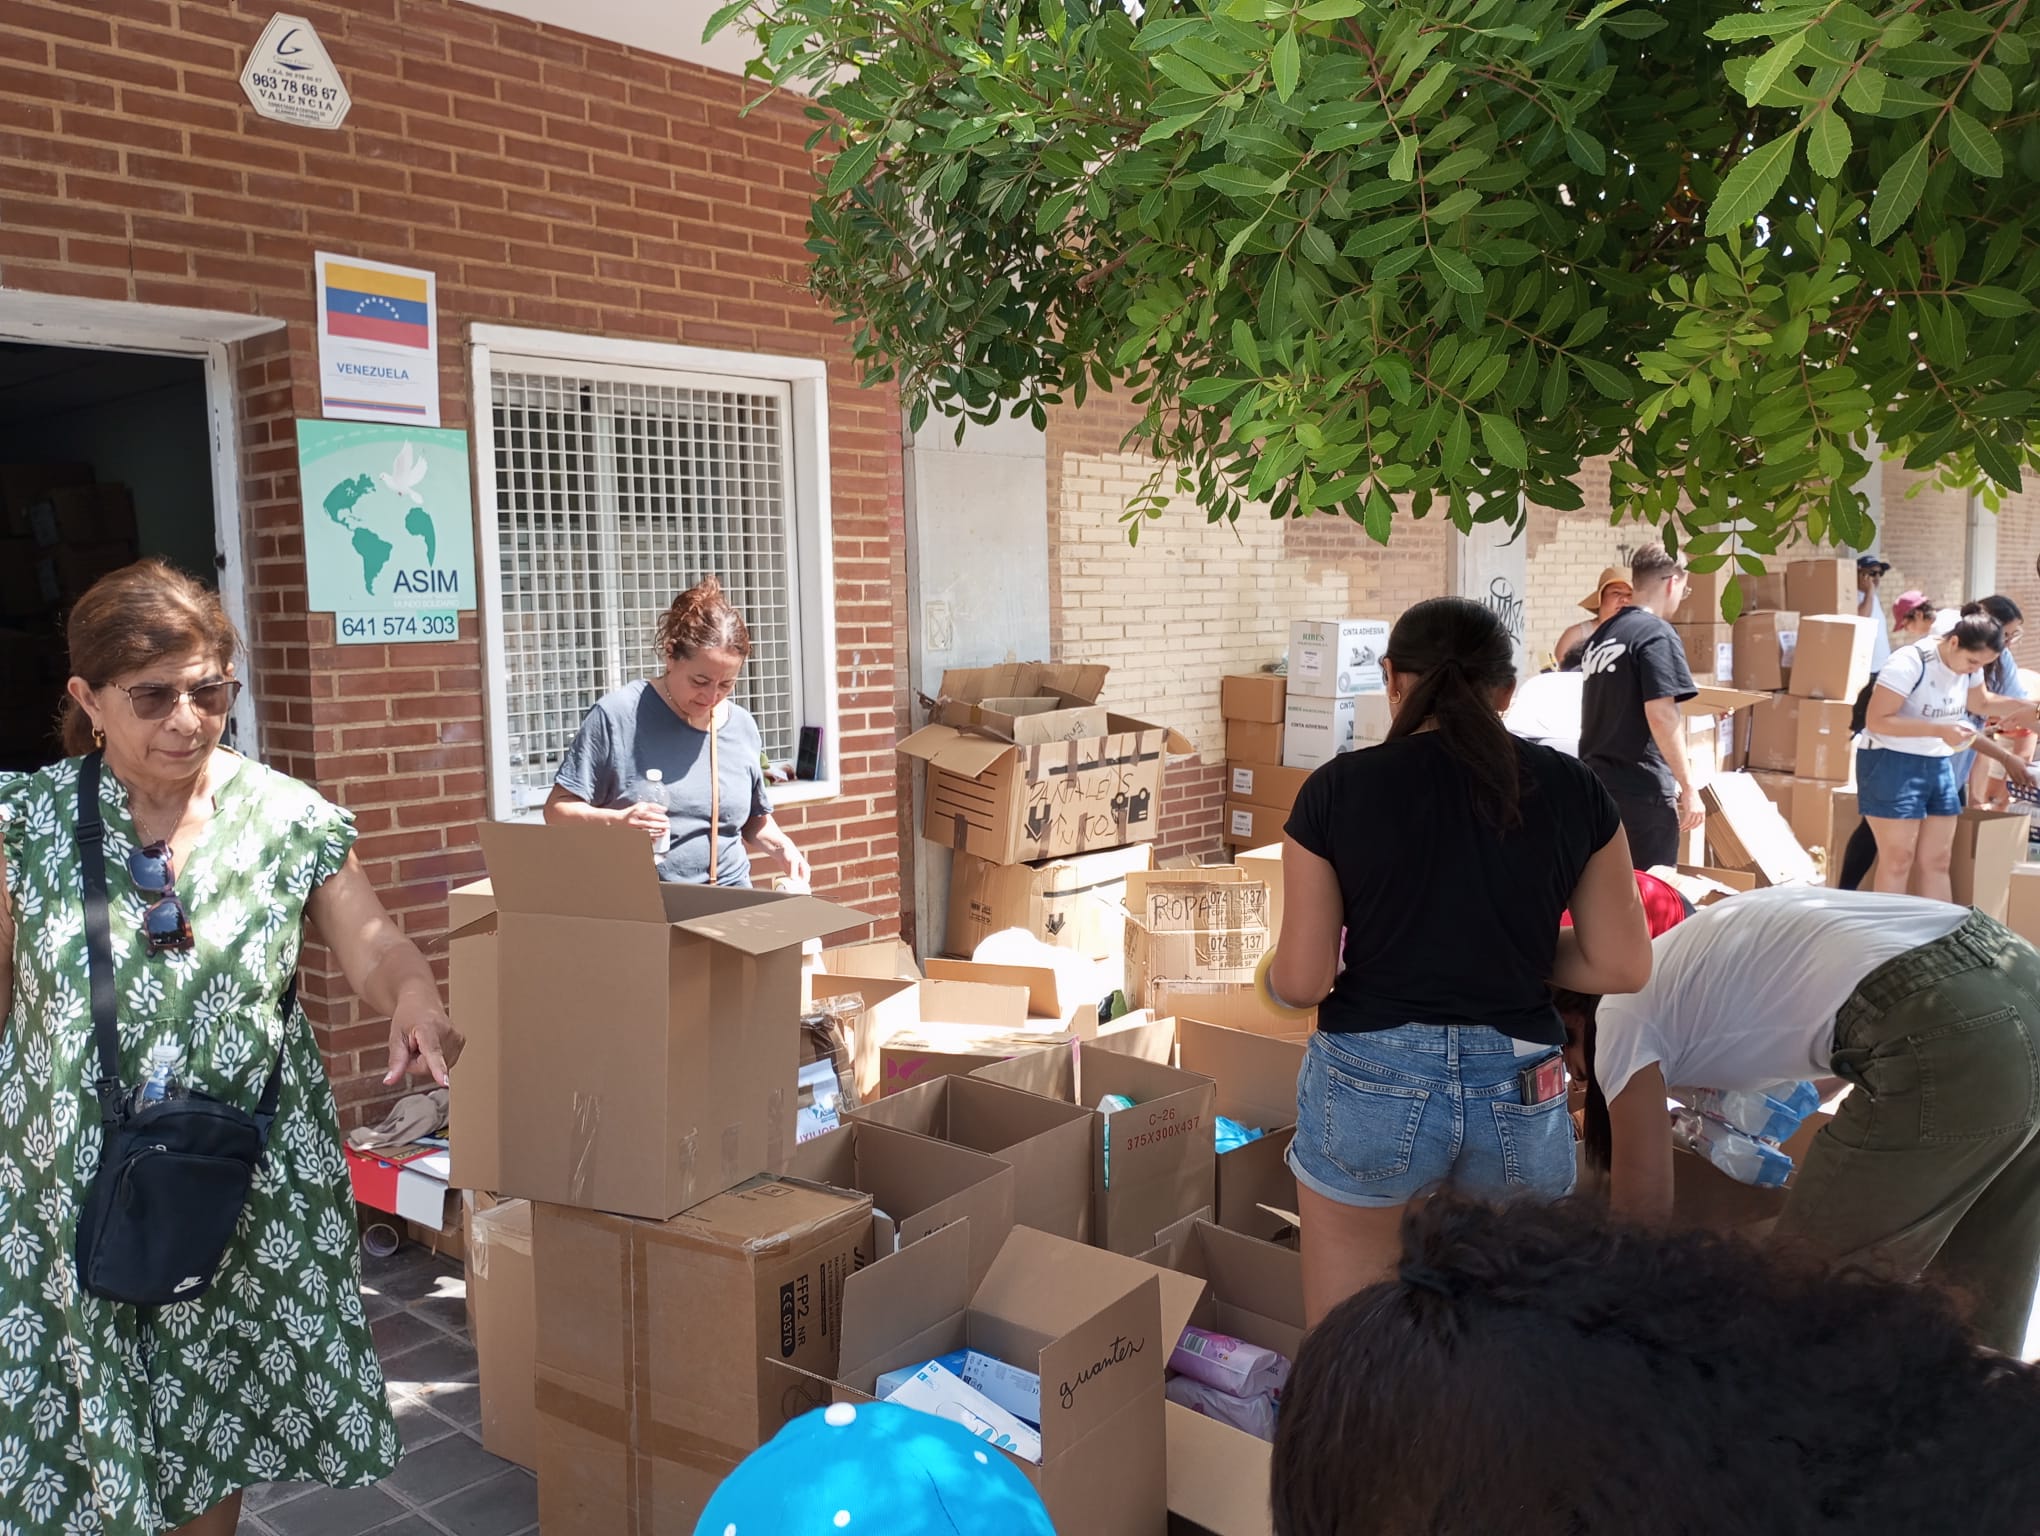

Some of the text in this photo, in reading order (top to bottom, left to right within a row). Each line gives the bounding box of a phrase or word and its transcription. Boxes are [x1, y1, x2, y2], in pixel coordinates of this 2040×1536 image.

[252, 72, 338, 101] 963 78 66 67
[259, 88, 333, 112] VALENCIA
[337, 362, 409, 380] VENEZUELA
[393, 569, 459, 593] ASIM
[342, 616, 455, 636] 641 574 303
[1343, 627, 1384, 637] CINTA ADHESIVA
[1210, 890, 1262, 905] 074-137
[1151, 894, 1211, 926] ROPA
[1210, 936, 1262, 951] 074-137
[1149, 1108, 1175, 1126] C-26
[1127, 1116, 1200, 1151] 375X300X437
[797, 1274, 810, 1347] FFP2 NR
[783, 1314, 793, 1347] 0370
